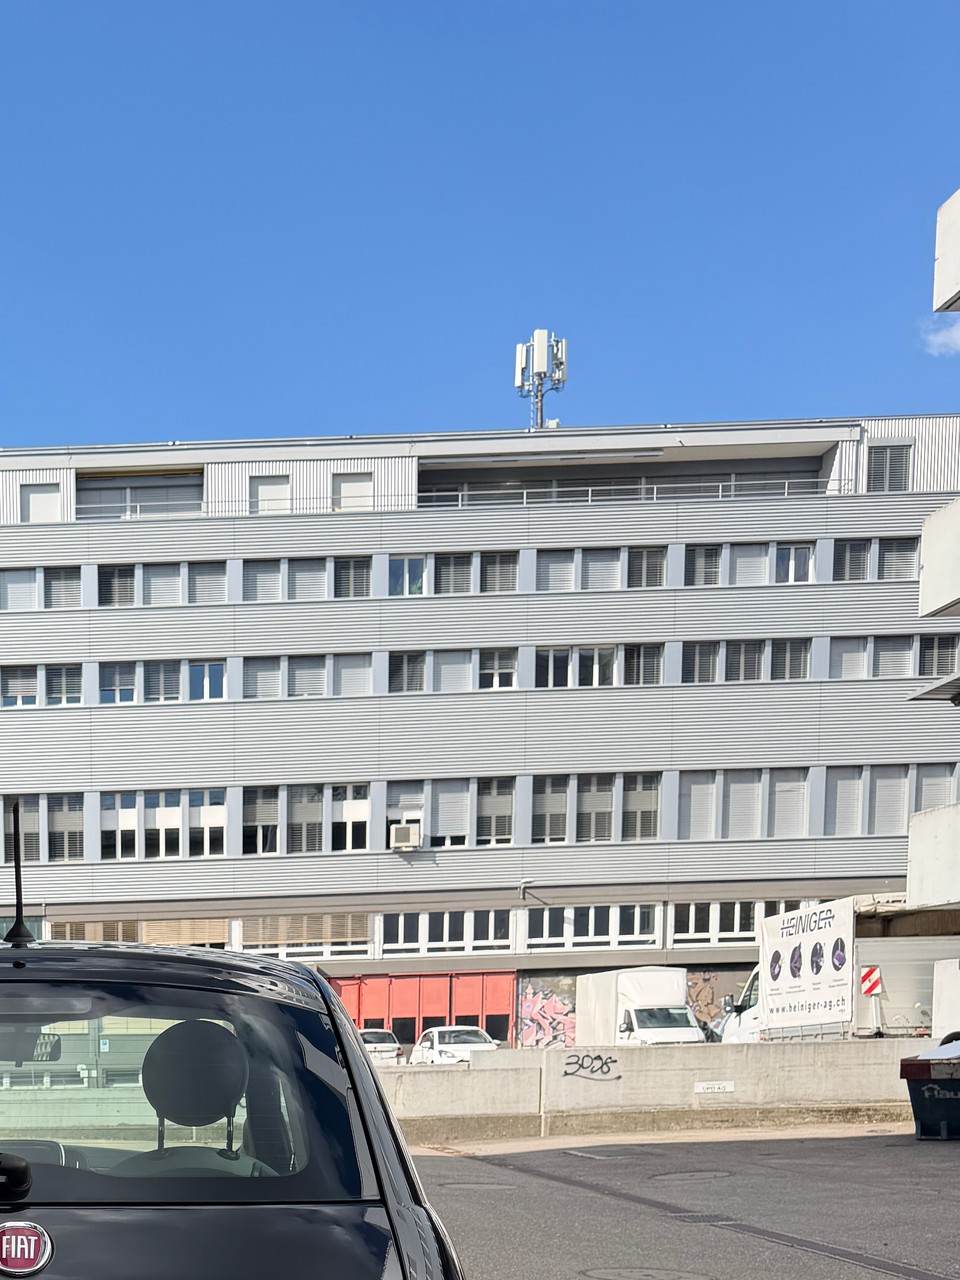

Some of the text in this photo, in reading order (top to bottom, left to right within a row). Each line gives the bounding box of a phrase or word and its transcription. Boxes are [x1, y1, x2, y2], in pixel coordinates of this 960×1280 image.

[781, 909, 835, 937] HEINIGER
[769, 996, 846, 1015] www.heiniger-ag.ch
[2, 1235, 38, 1259] FIAT
